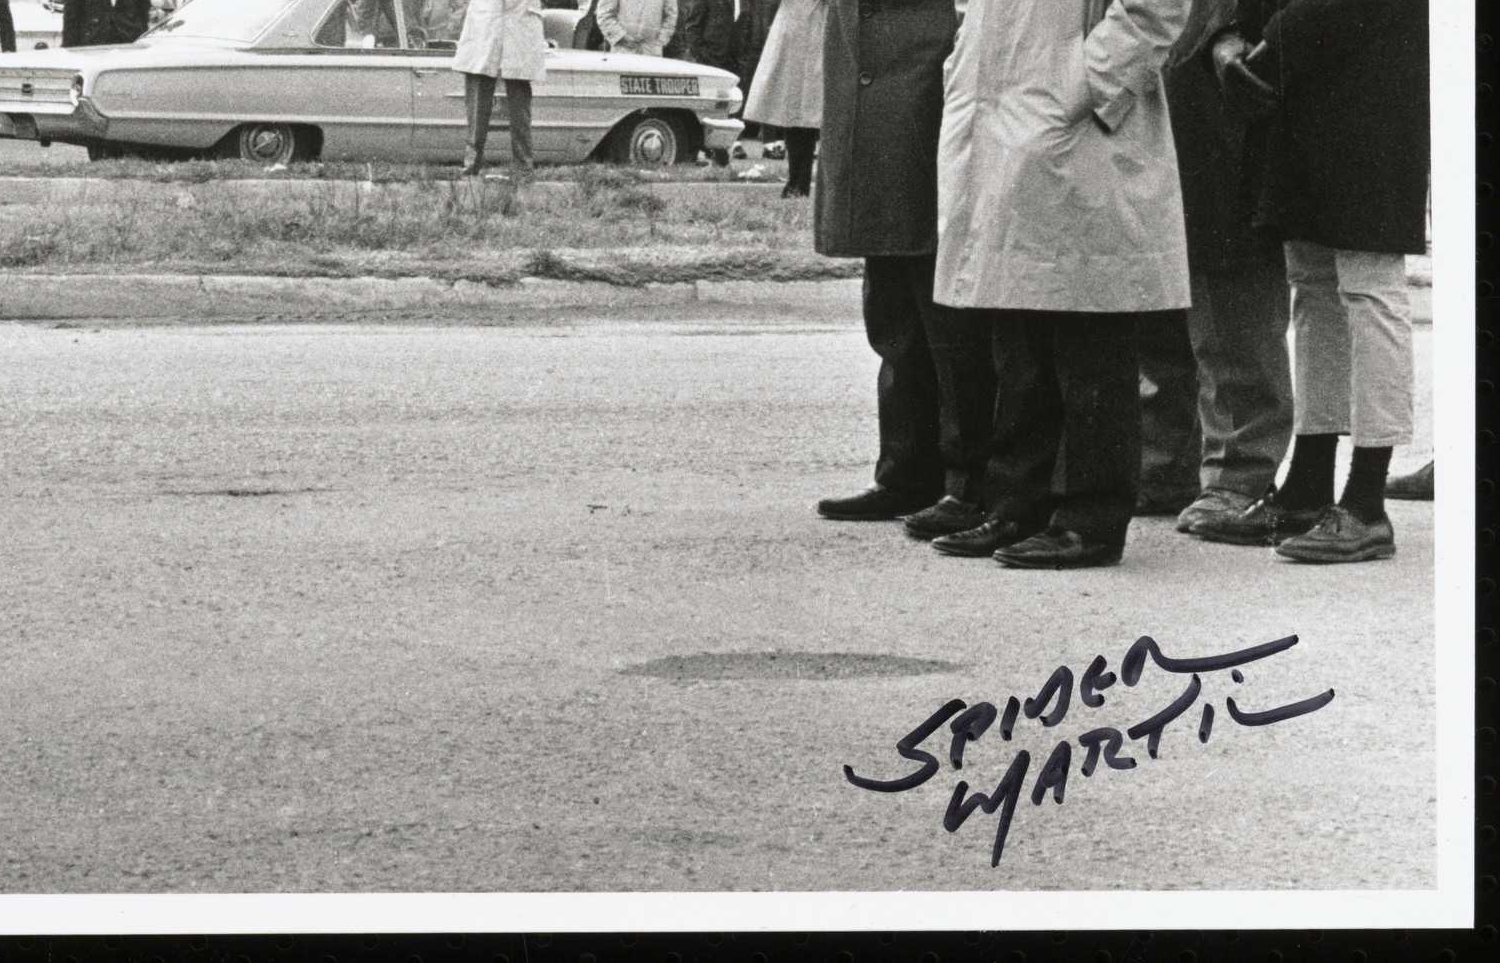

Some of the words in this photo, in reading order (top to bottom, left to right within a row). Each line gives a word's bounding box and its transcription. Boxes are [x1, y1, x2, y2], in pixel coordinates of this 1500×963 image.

[621, 77, 652, 94] STATE
[654, 78, 699, 95] TROOPER
[843, 634, 1299, 793] SPIDER
